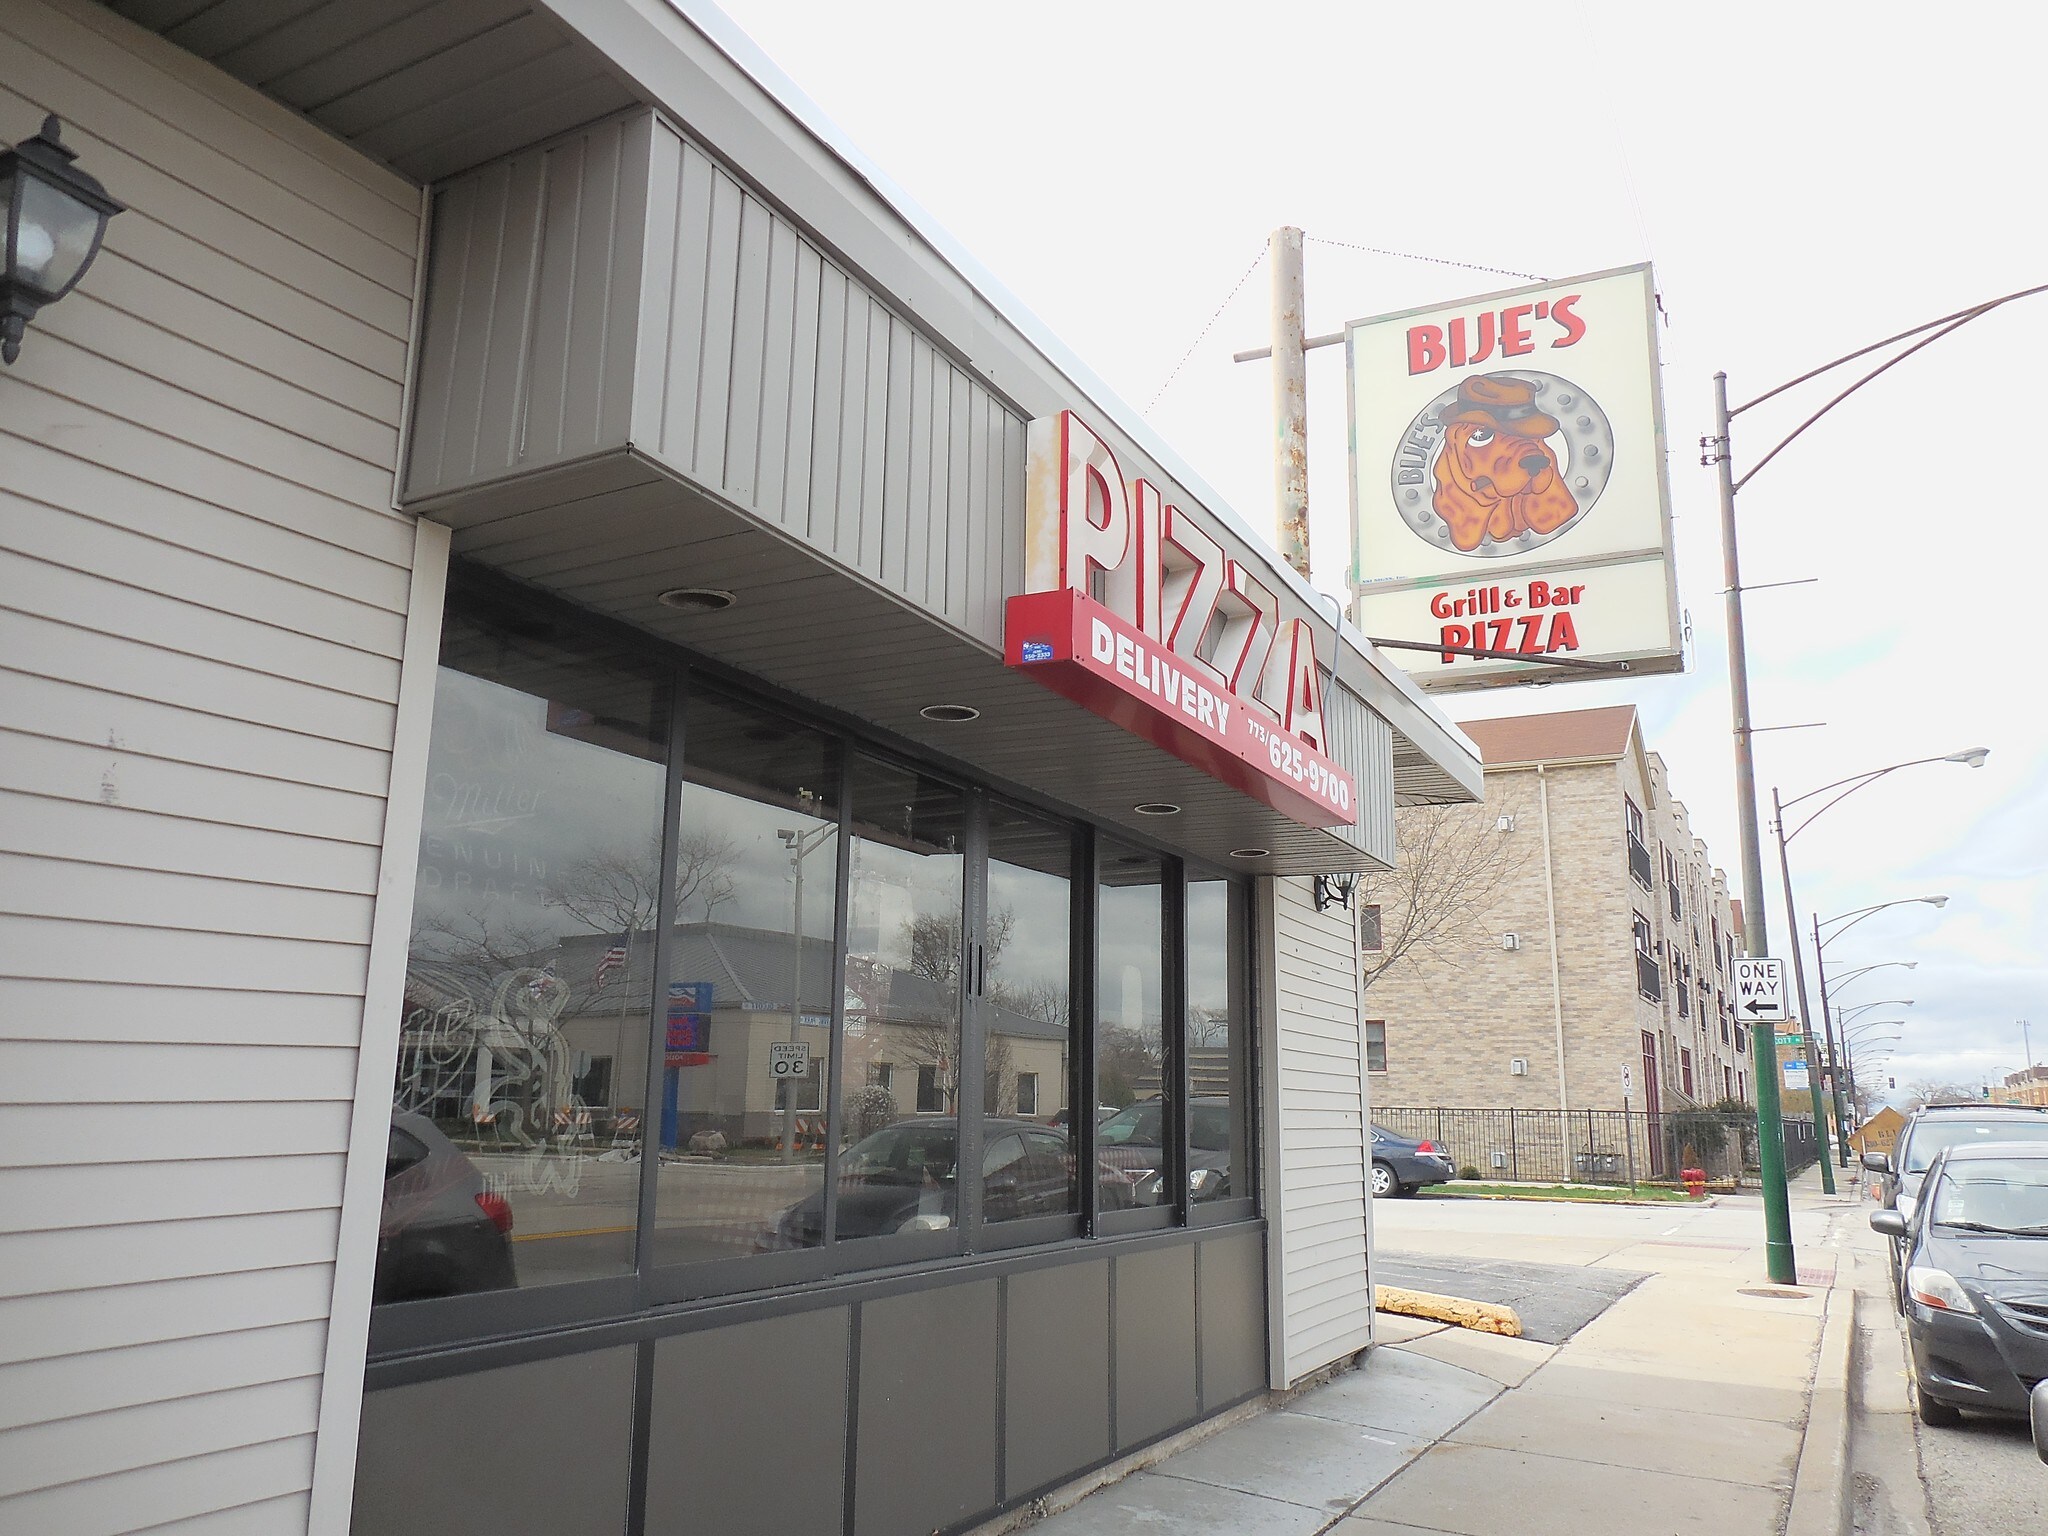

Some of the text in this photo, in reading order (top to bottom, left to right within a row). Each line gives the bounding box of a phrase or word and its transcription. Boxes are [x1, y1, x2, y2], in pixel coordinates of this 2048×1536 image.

[1406, 294, 1587, 376] BIJE'S
[1398, 412, 1445, 485] BIJE'S
[1060, 409, 1329, 758] PIZZA
[1431, 580, 1586, 619] Grill & Bar
[1441, 612, 1580, 664] PIZZA
[1091, 616, 1230, 736] DELIVERY
[1739, 964, 1778, 979] ONE
[1739, 981, 1779, 997] WAY
